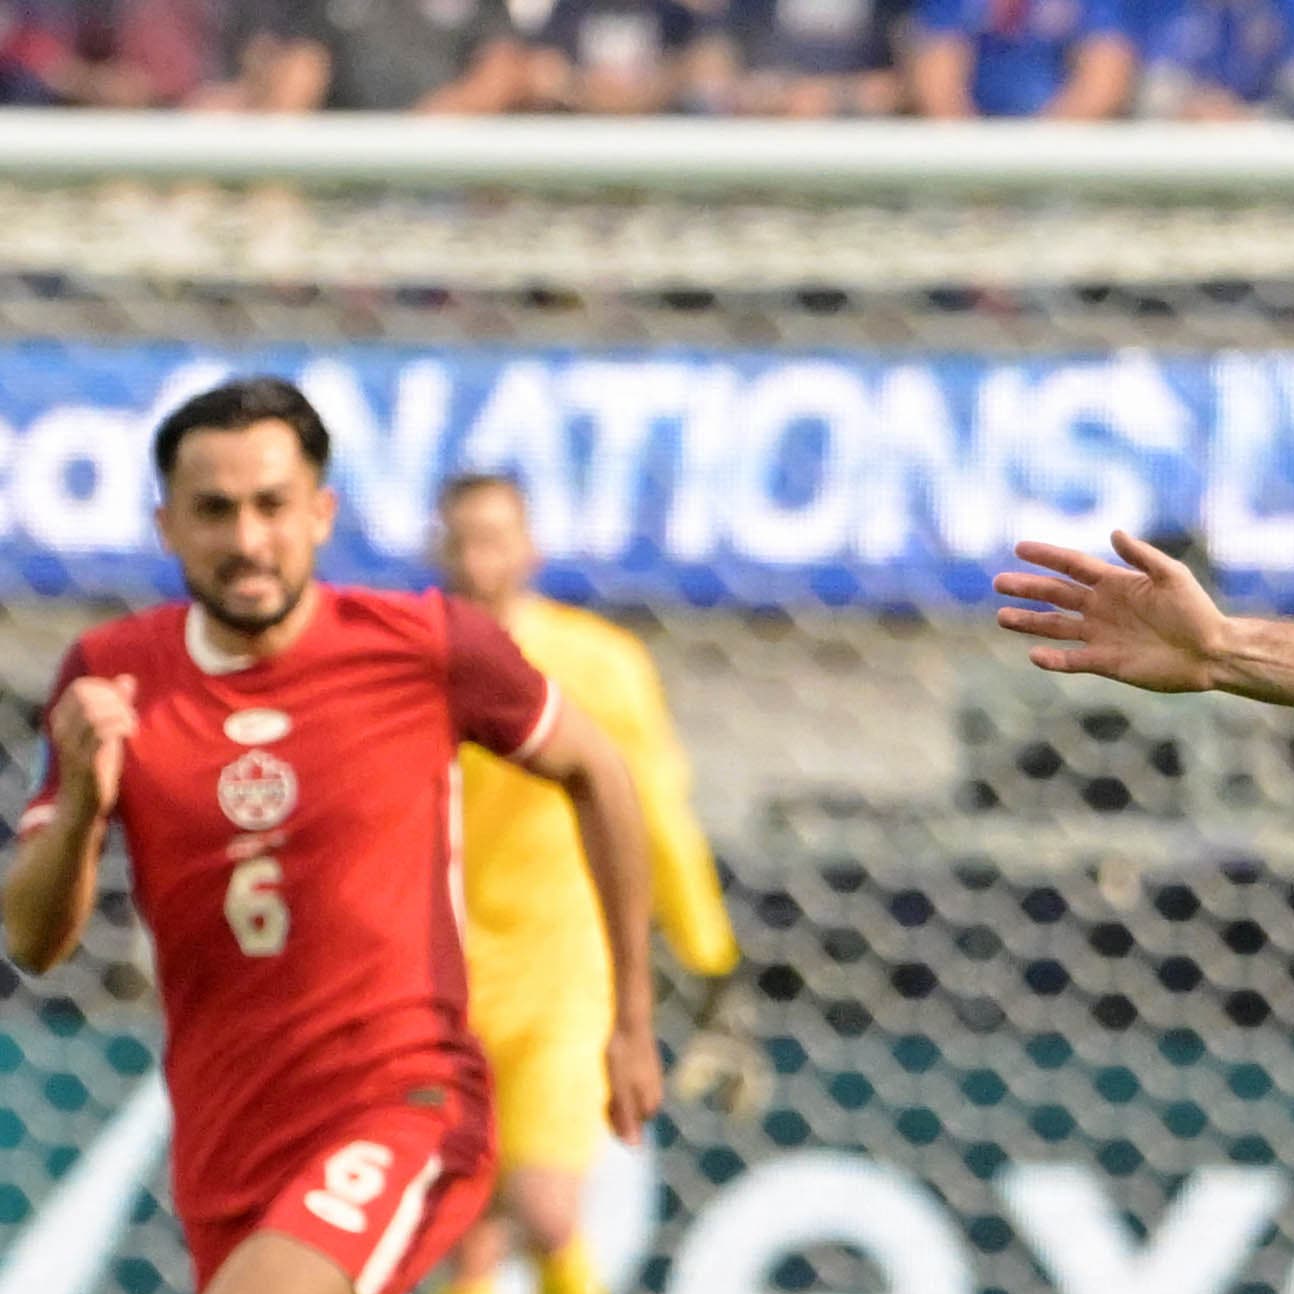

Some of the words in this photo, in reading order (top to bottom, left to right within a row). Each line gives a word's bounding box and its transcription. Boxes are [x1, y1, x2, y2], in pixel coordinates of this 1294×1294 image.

[297, 355, 1180, 566] NATIONS
[224, 856, 290, 958] 6
[323, 1140, 394, 1206] 6
